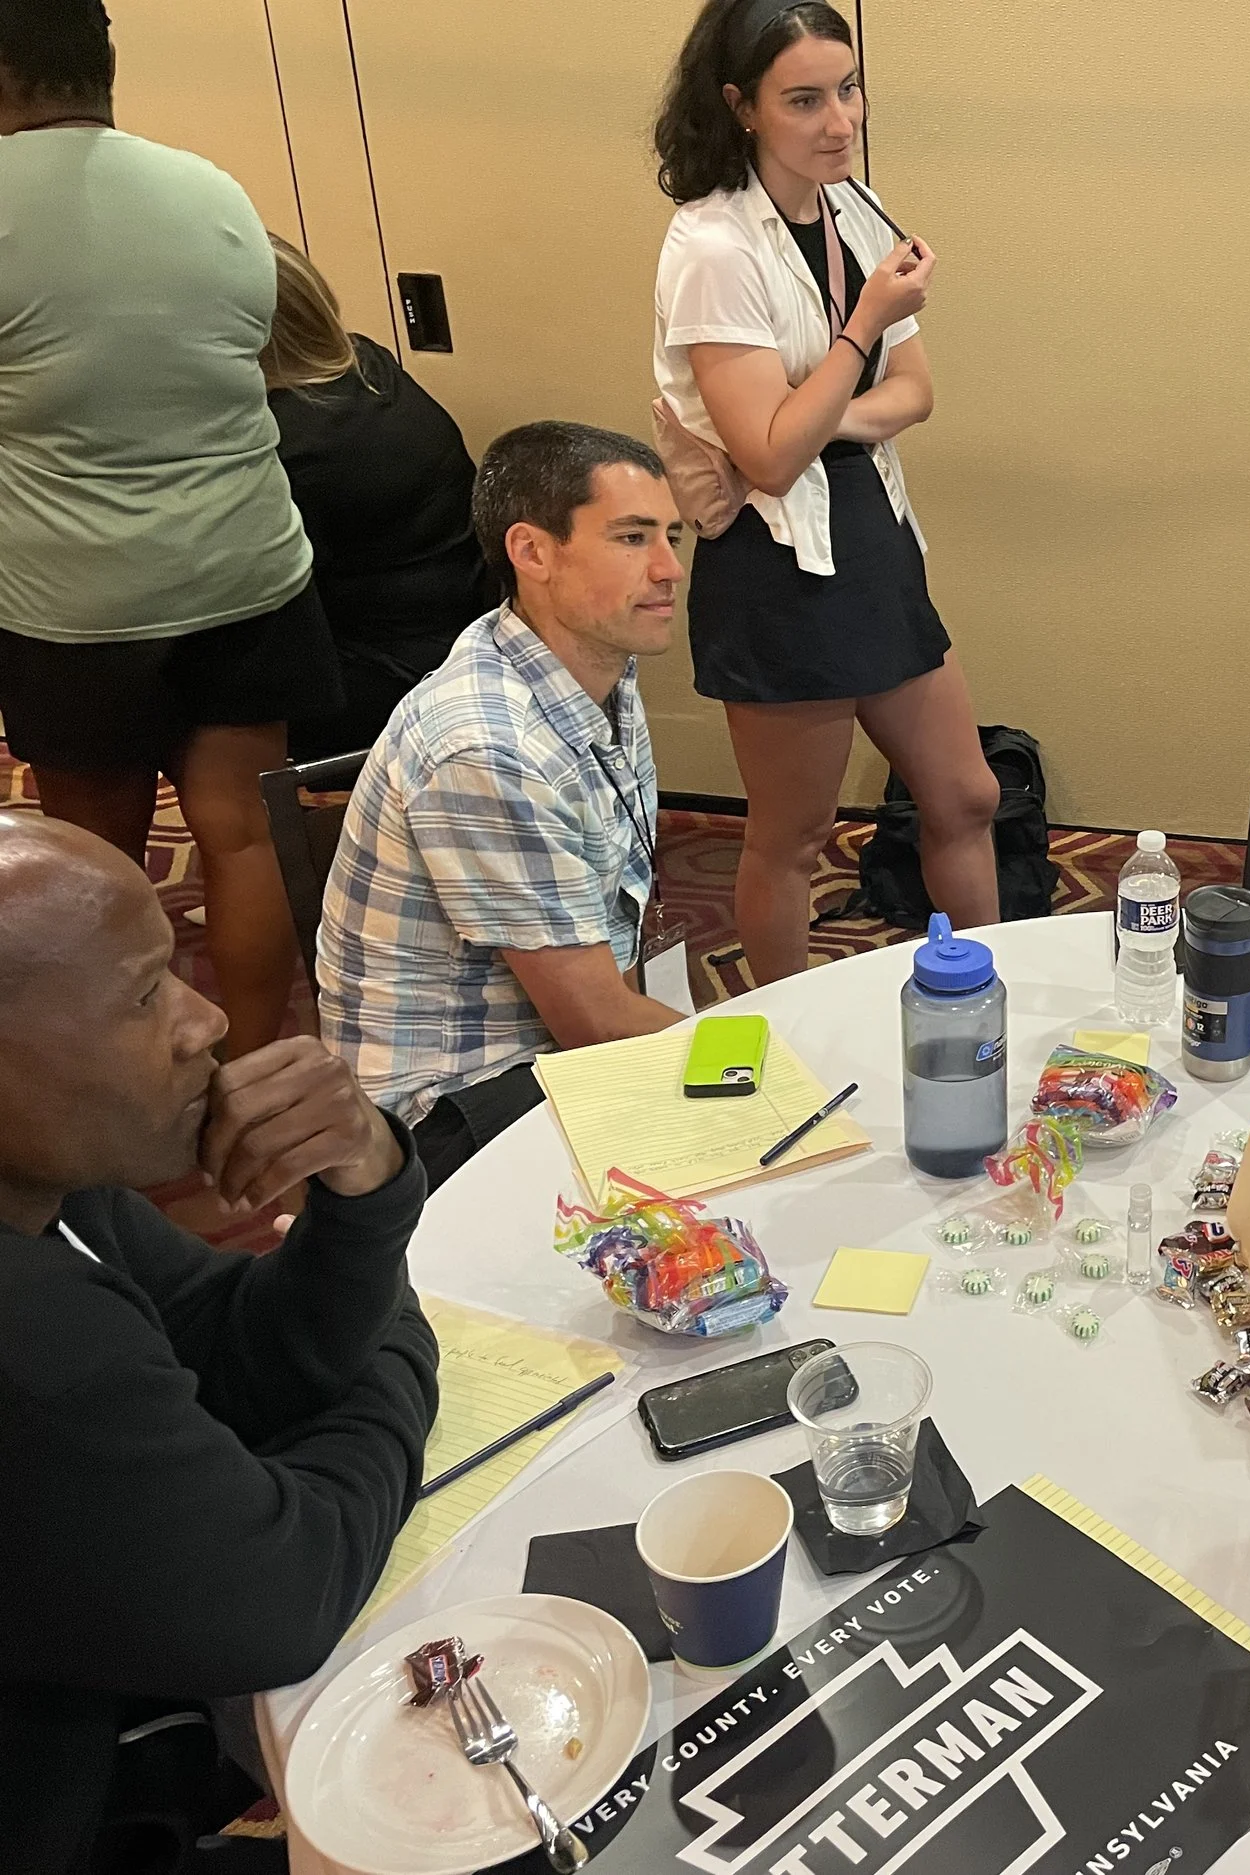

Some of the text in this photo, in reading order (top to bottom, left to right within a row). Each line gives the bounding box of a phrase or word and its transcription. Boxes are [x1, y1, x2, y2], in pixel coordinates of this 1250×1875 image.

[1140, 904, 1173, 916] DEER
[1140, 915, 1173, 926] PARK
[575, 1774, 651, 1834] VERY
[782, 1616, 864, 1680] EVERY
[867, 1567, 940, 1615] VOTE.
[768, 1666, 1054, 1875] TTERMAN
[1074, 1740, 1239, 1875] NSYLVANIA
